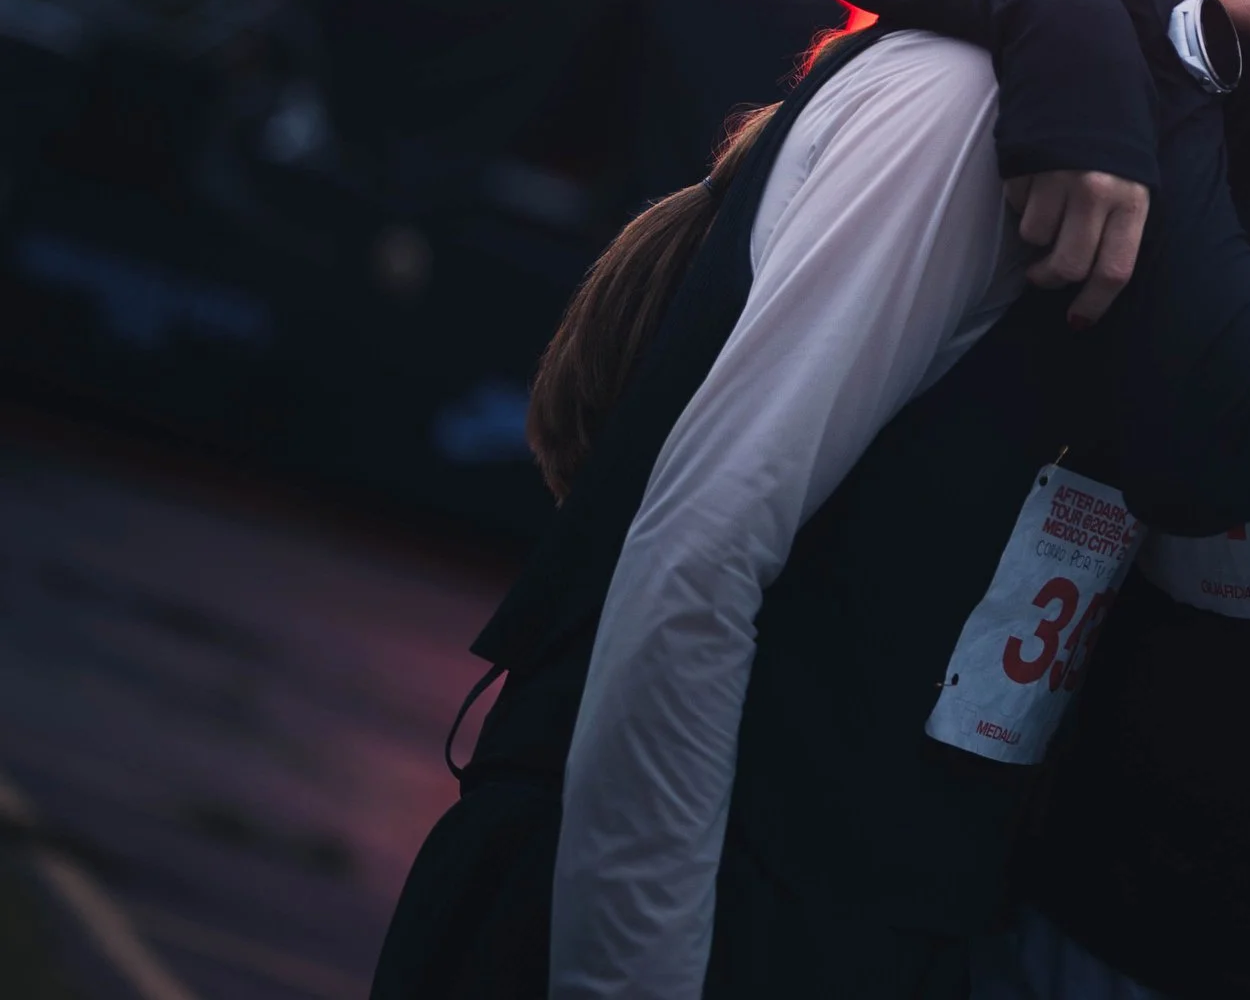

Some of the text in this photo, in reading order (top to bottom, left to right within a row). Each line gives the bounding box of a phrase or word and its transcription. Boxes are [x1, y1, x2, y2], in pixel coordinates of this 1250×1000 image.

[1051, 500, 1083, 526] TOUR
[1054, 485, 1128, 525] AFTER DARK
[1042, 517, 1088, 546] MEXICO
[1088, 535, 1120, 557] CITY
